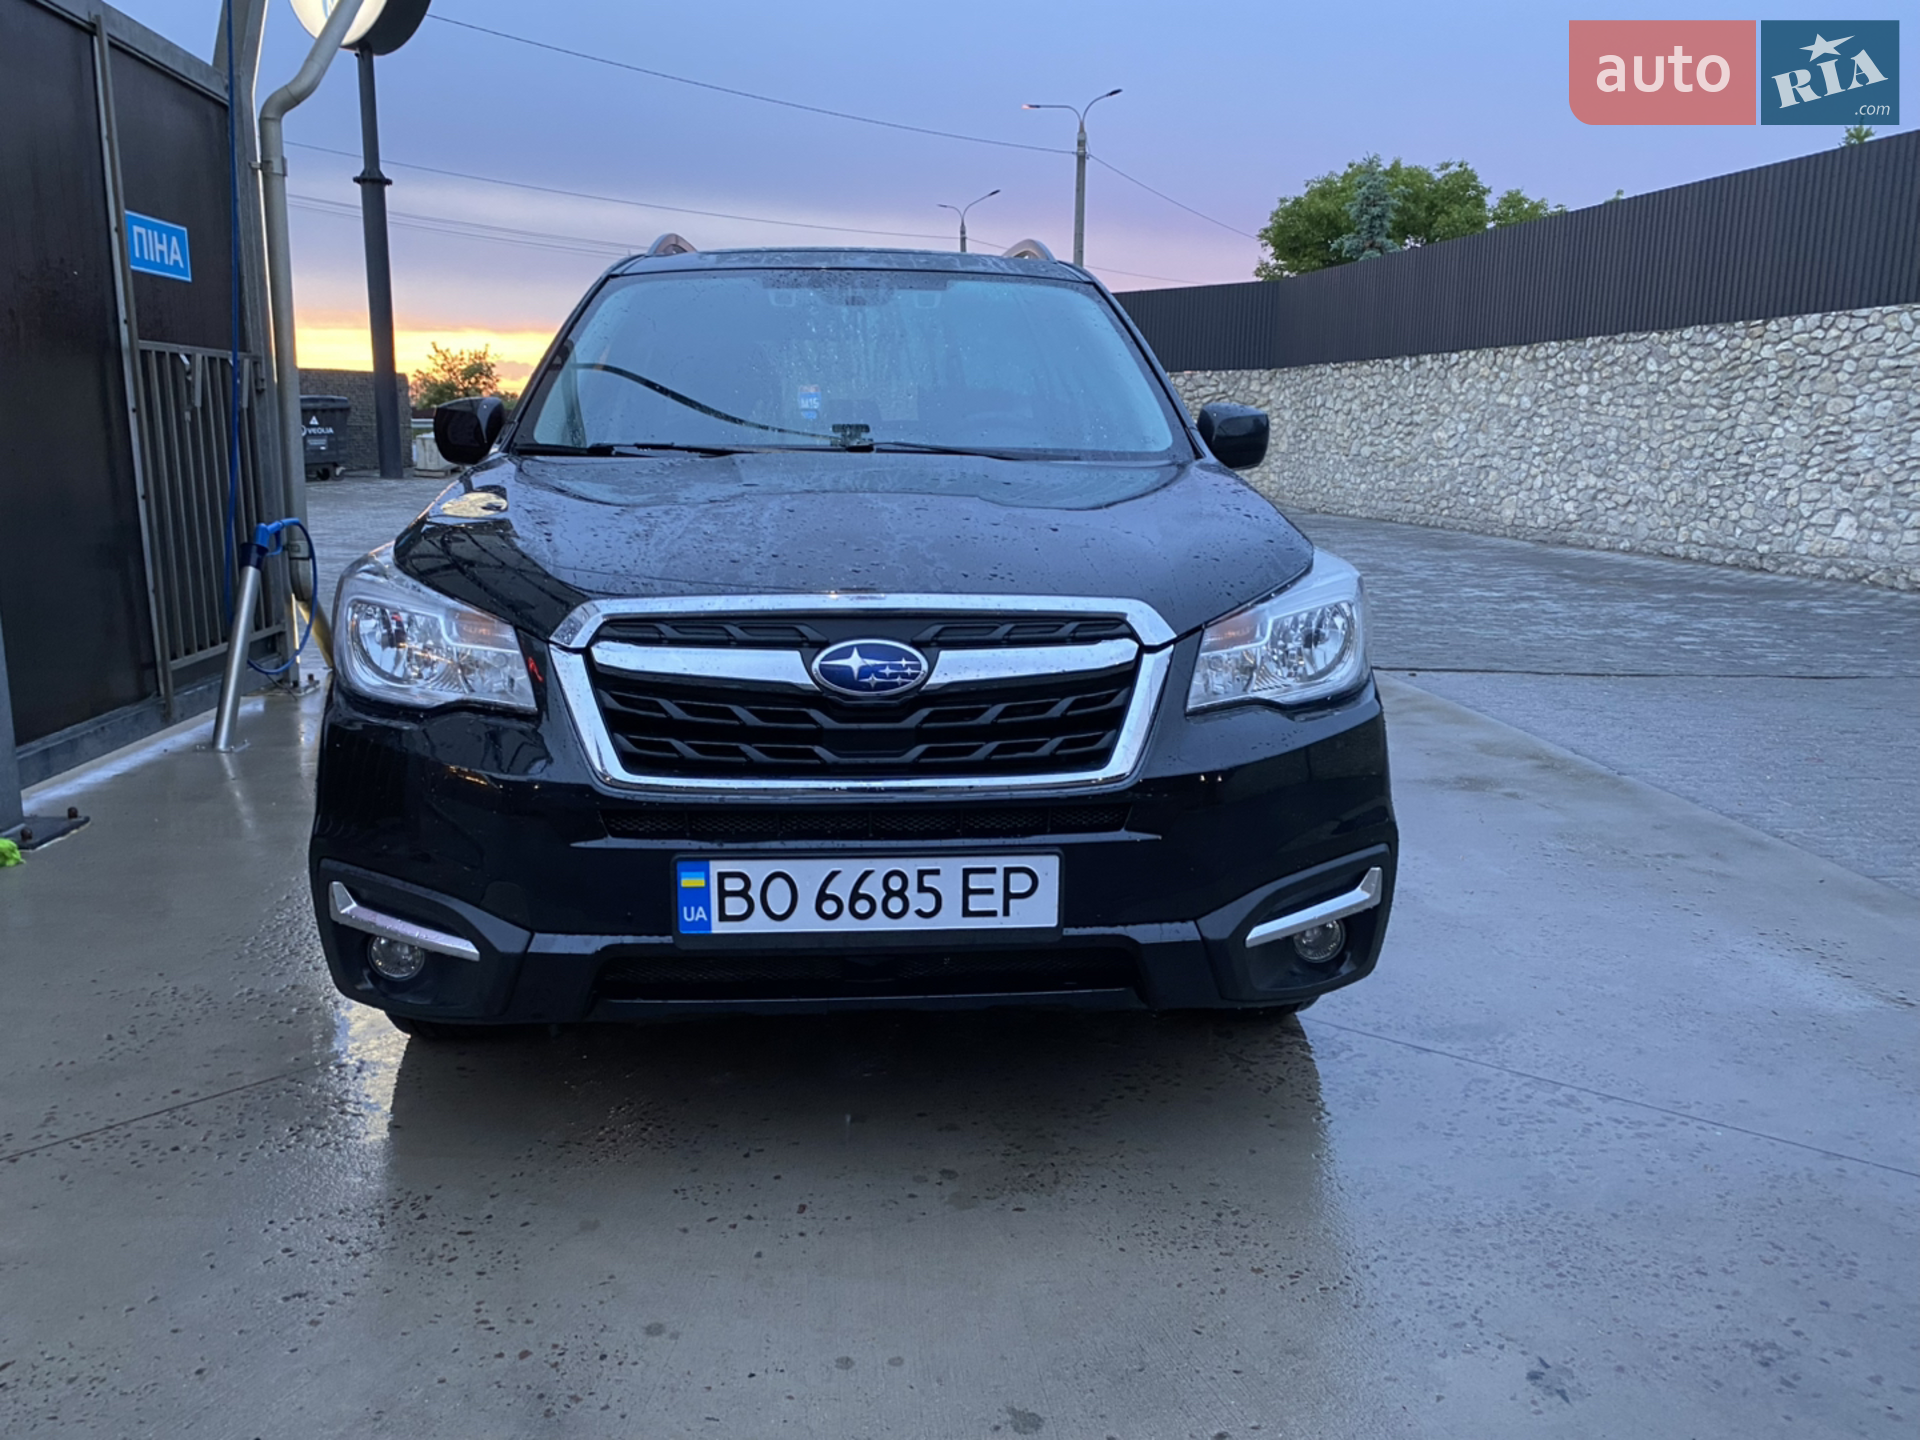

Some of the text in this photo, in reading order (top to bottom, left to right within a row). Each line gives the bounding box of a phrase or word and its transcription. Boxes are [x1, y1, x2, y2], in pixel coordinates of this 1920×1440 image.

[132, 224, 185, 269] ПІНА
[683, 906, 708, 922] UA
[716, 866, 1040, 923] BO 6685 EP
